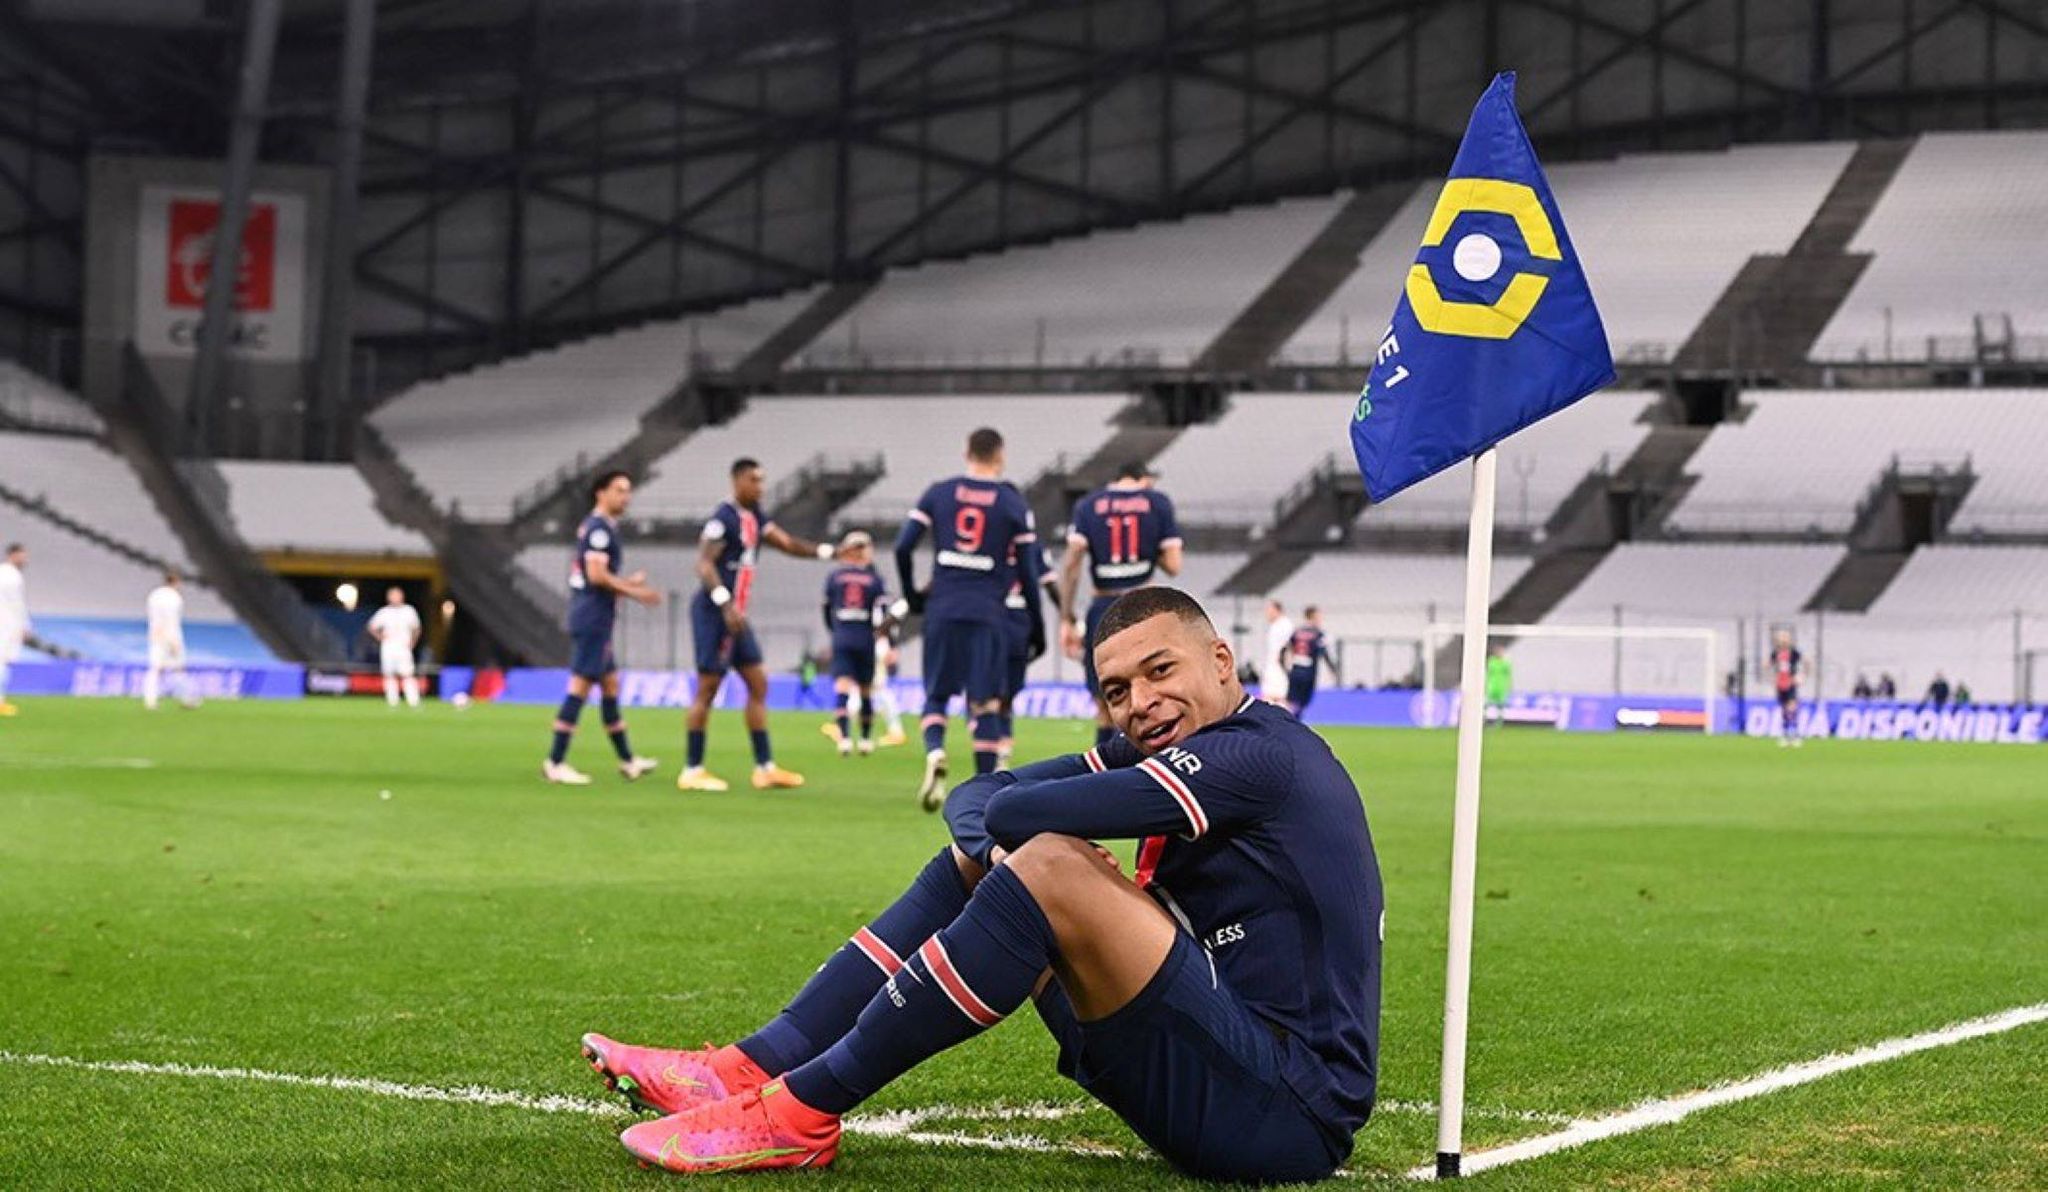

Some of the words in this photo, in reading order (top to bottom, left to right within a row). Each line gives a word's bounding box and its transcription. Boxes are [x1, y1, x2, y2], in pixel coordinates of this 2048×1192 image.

[1385, 365, 1410, 388] 1
[955, 506, 987, 553] 9
[1106, 513, 1139, 564] 11
